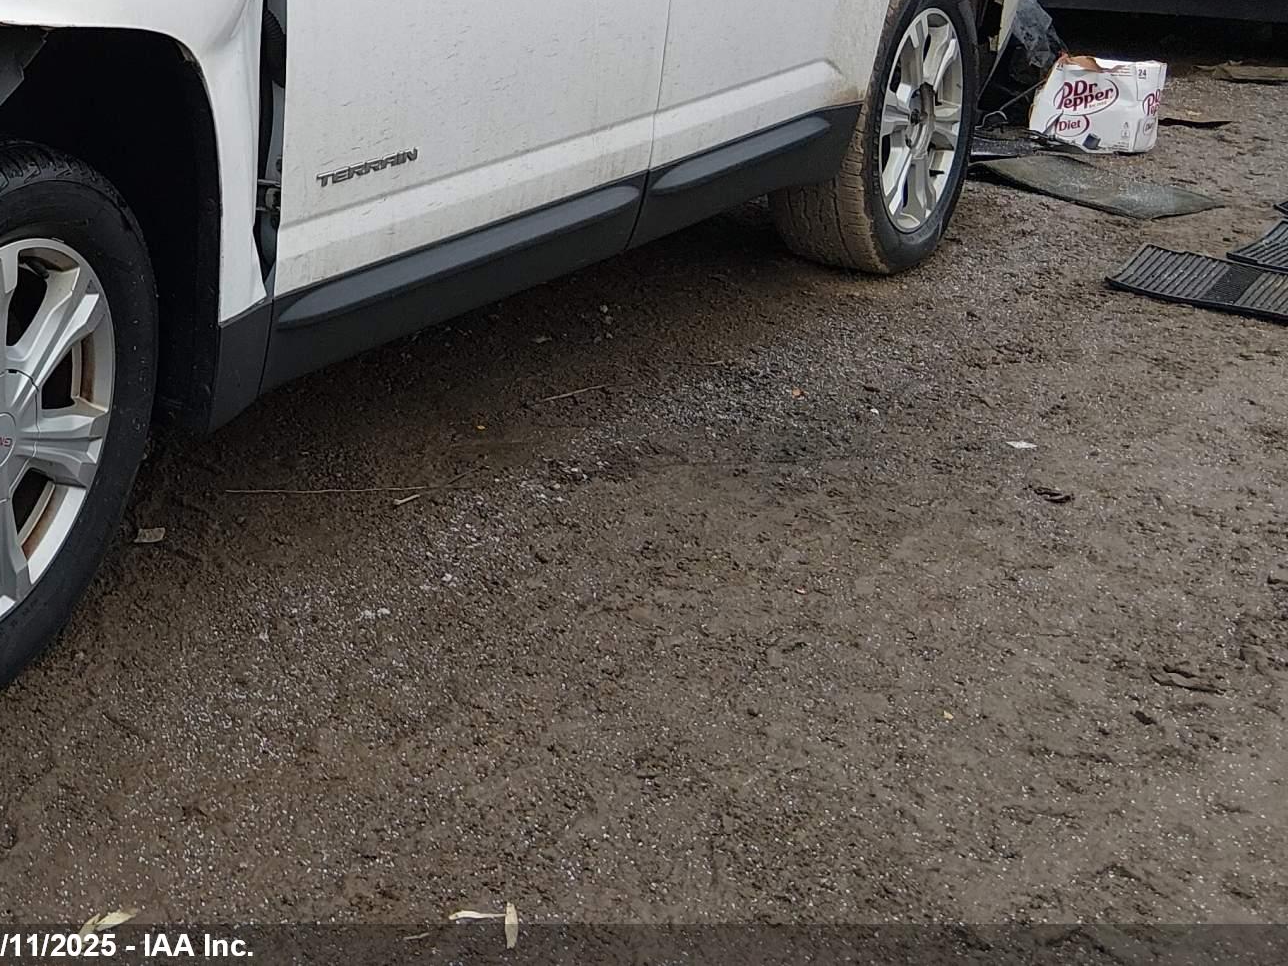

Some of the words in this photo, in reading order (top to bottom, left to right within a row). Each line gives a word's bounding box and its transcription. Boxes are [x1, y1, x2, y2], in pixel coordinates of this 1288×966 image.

[1056, 81, 1114, 111] Pepper
[1074, 79, 1098, 97] Dr
[1058, 119, 1082, 132] Diet
[316, 146, 418, 187] TERRAIN
